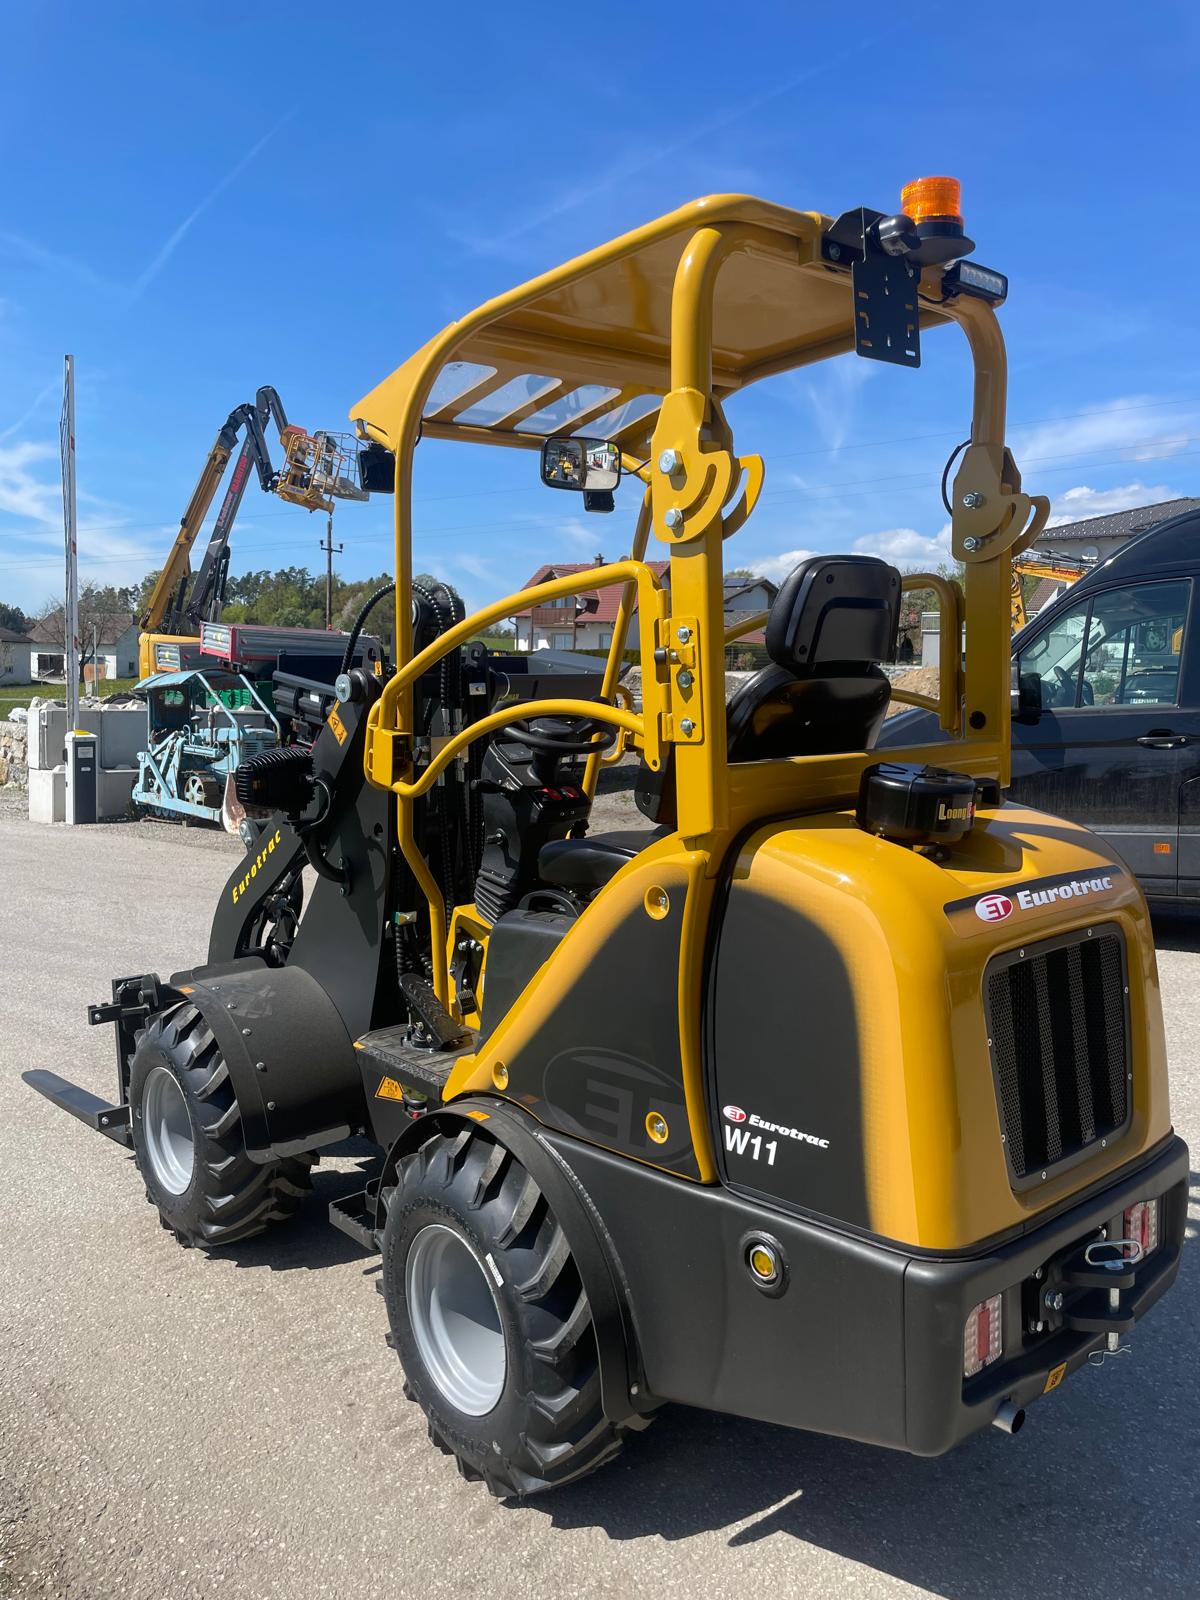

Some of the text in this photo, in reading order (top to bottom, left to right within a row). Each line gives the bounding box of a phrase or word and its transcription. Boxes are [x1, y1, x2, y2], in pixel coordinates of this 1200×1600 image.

[232, 829, 281, 905] Eurotrac
[1016, 876, 1113, 910] Eurotrac
[724, 1125, 778, 1166] W11
[748, 1114, 830, 1149] Eurotrac
